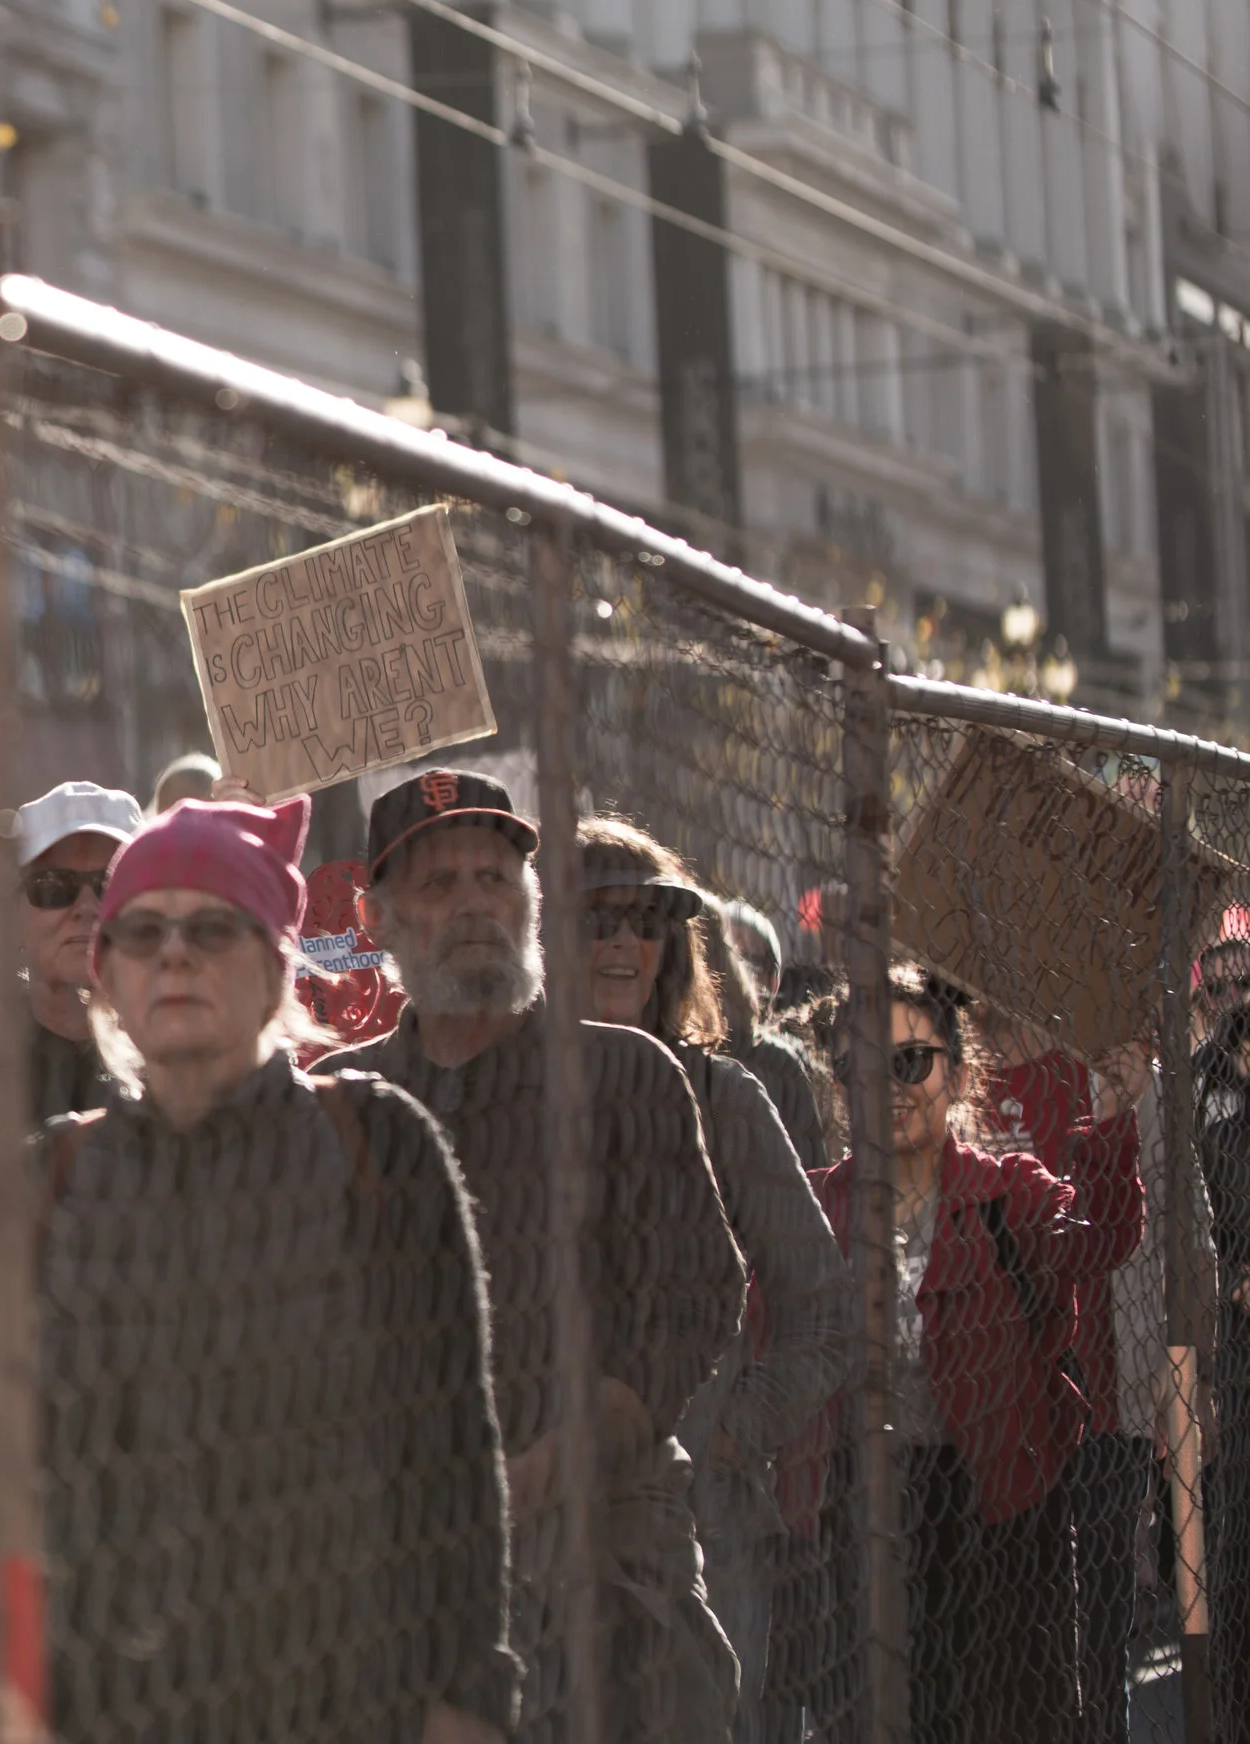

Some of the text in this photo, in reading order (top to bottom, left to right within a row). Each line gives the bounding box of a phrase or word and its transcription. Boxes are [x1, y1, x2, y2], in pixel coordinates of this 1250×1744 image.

[193, 523, 421, 635] THE CLIMATE
[206, 572, 446, 690] IS CHANGING
[221, 674, 318, 755] WHY
[301, 699, 435, 783] WE?
[299, 928, 356, 954] lanned
